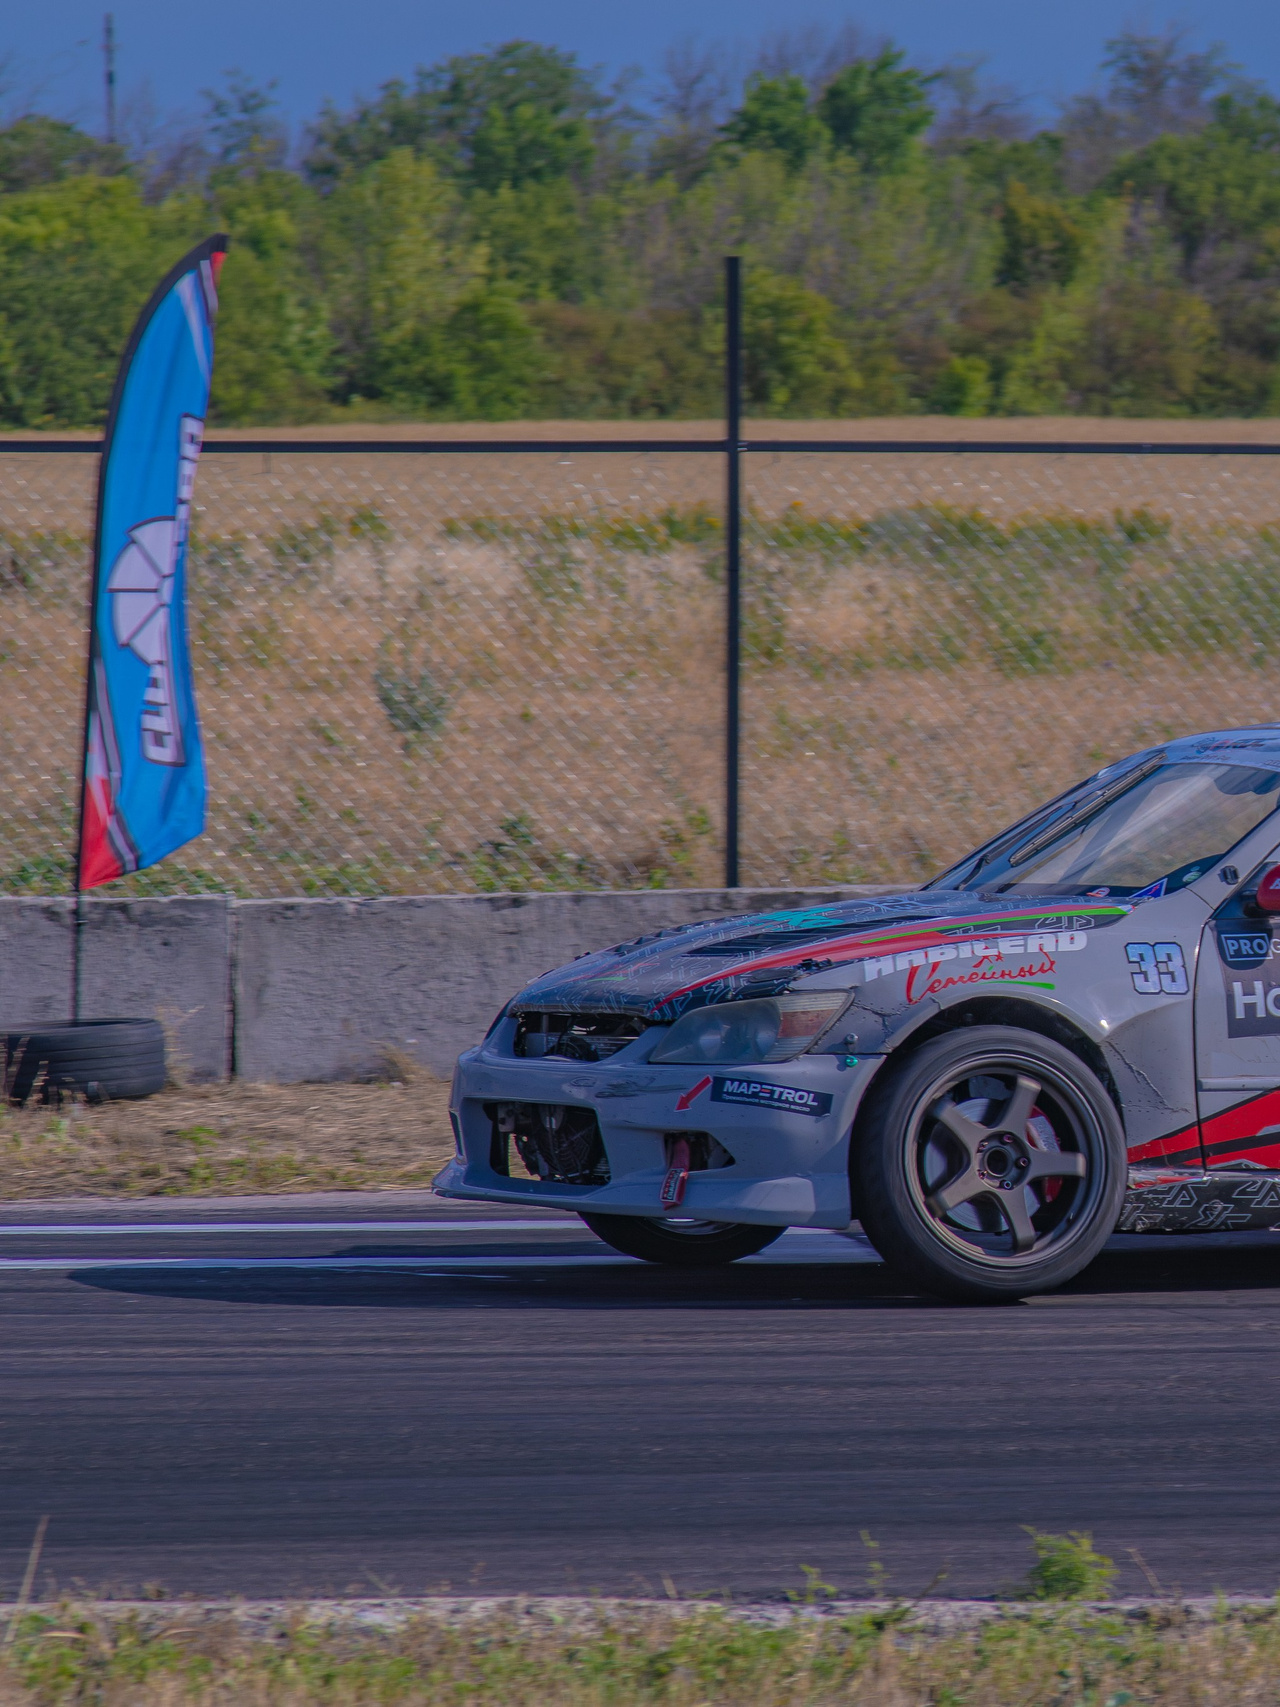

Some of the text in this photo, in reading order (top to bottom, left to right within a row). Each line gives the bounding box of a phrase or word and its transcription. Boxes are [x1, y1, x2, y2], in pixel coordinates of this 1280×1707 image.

[864, 931, 1088, 983] HABILEAD
[1125, 941, 1190, 995] 33
[723, 1080, 818, 1106] MAPETROL
